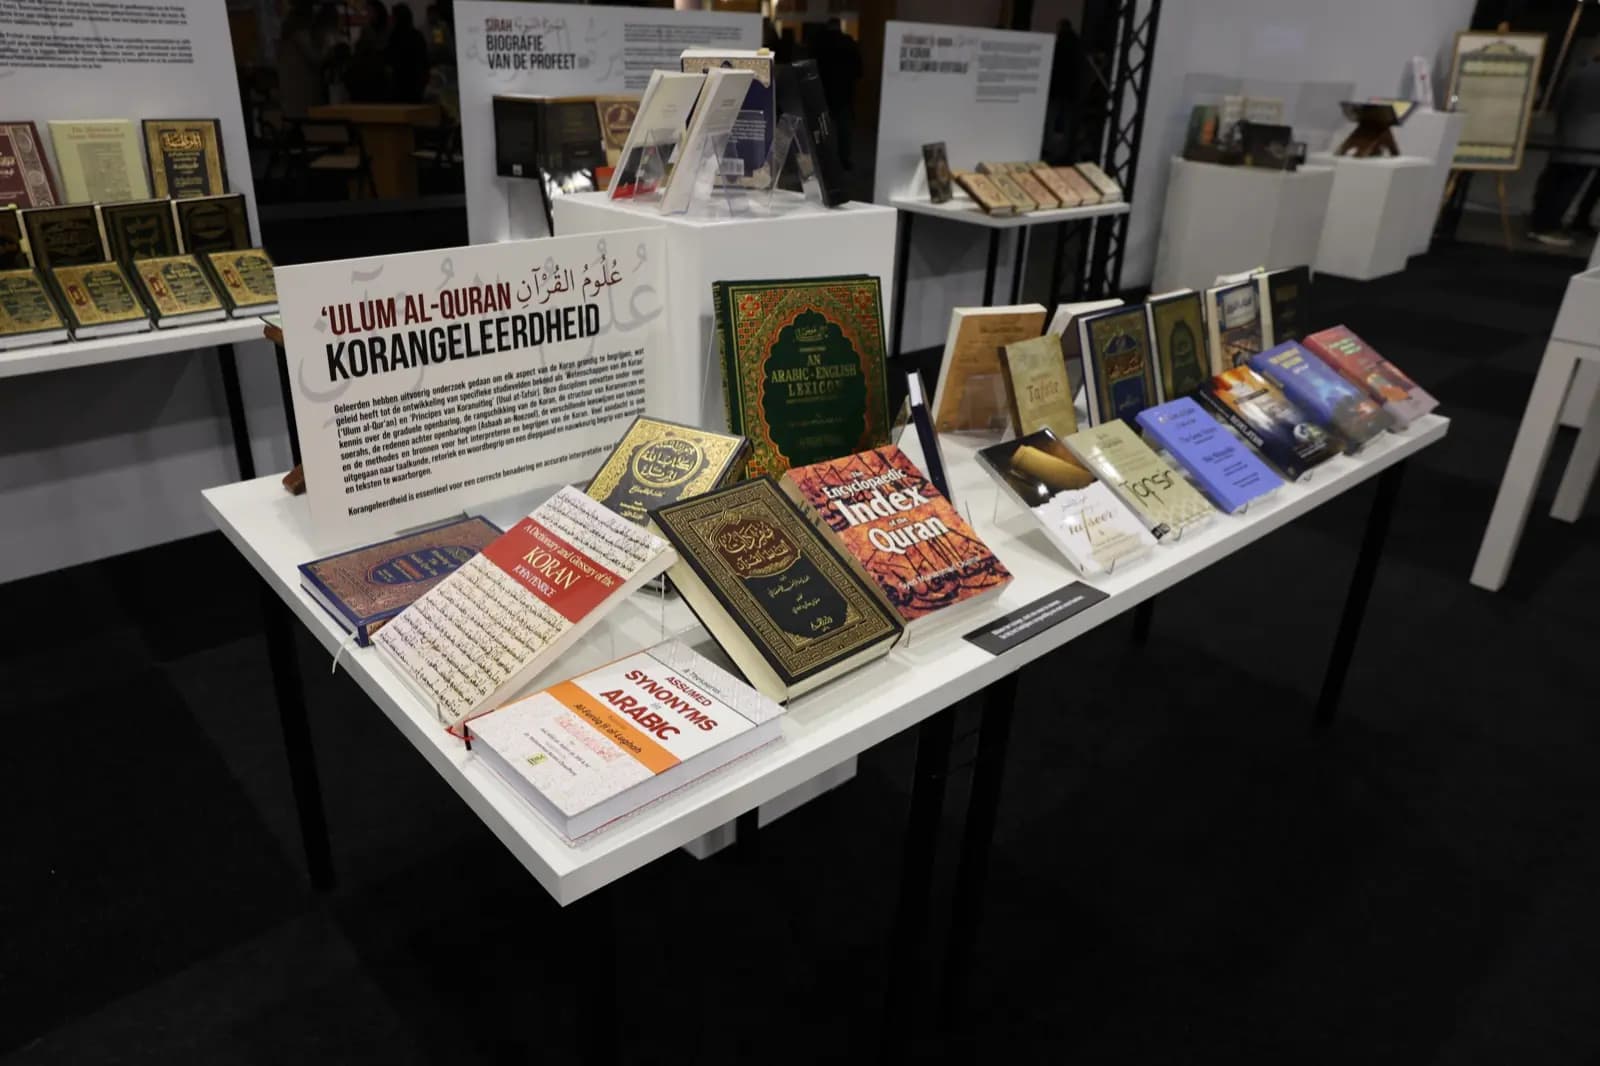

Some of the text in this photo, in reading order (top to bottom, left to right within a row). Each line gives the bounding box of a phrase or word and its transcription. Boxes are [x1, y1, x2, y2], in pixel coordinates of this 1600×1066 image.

[485, 18, 512, 32] SIRAH
[486, 34, 543, 51] BIOGRAFIE
[488, 53, 576, 70] VAN DE PROFEET
[404, 282, 512, 323] AL-QURAN
[326, 303, 600, 382] KORANGELEERDHEID
[807, 354, 821, 366] AN
[334, 401, 370, 414] Geleerden
[372, 395, 398, 406] hebben
[400, 388, 430, 401] uitvoerig
[336, 413, 358, 427] geleid
[359, 409, 378, 421] heeft
[380, 407, 390, 416] tot
[392, 406, 401, 414] de
[402, 398, 445, 412] ontwikkeling
[339, 437, 363, 449] kennis
[364, 434, 380, 443] over
[382, 431, 391, 439] de
[393, 424, 422, 439] graduele
[372, 445, 381, 453] de
[382, 439, 410, 451] redenen
[411, 434, 432, 445] achter
[353, 460, 363, 469] de
[365, 453, 399, 466] methodes
[412, 444, 439, 456] bronnen
[344, 469, 378, 483] uitgegaan
[379, 465, 394, 474] naar
[355, 479, 382, 491] teksten
[822, 468, 907, 499] Encyclopaedic
[348, 494, 408, 516] Korangeleerdheid
[834, 486, 930, 526] Index
[868, 515, 950, 554] Quran
[522, 546, 581, 590] KORAN
[530, 526, 559, 552] Dictionary
[557, 548, 574, 559] and
[569, 554, 596, 577] Glossary
[601, 574, 614, 587] the
[624, 670, 718, 731] SYNONYMS
[666, 676, 712, 707] ASSUMED
[600, 689, 680, 740] ARABIC
